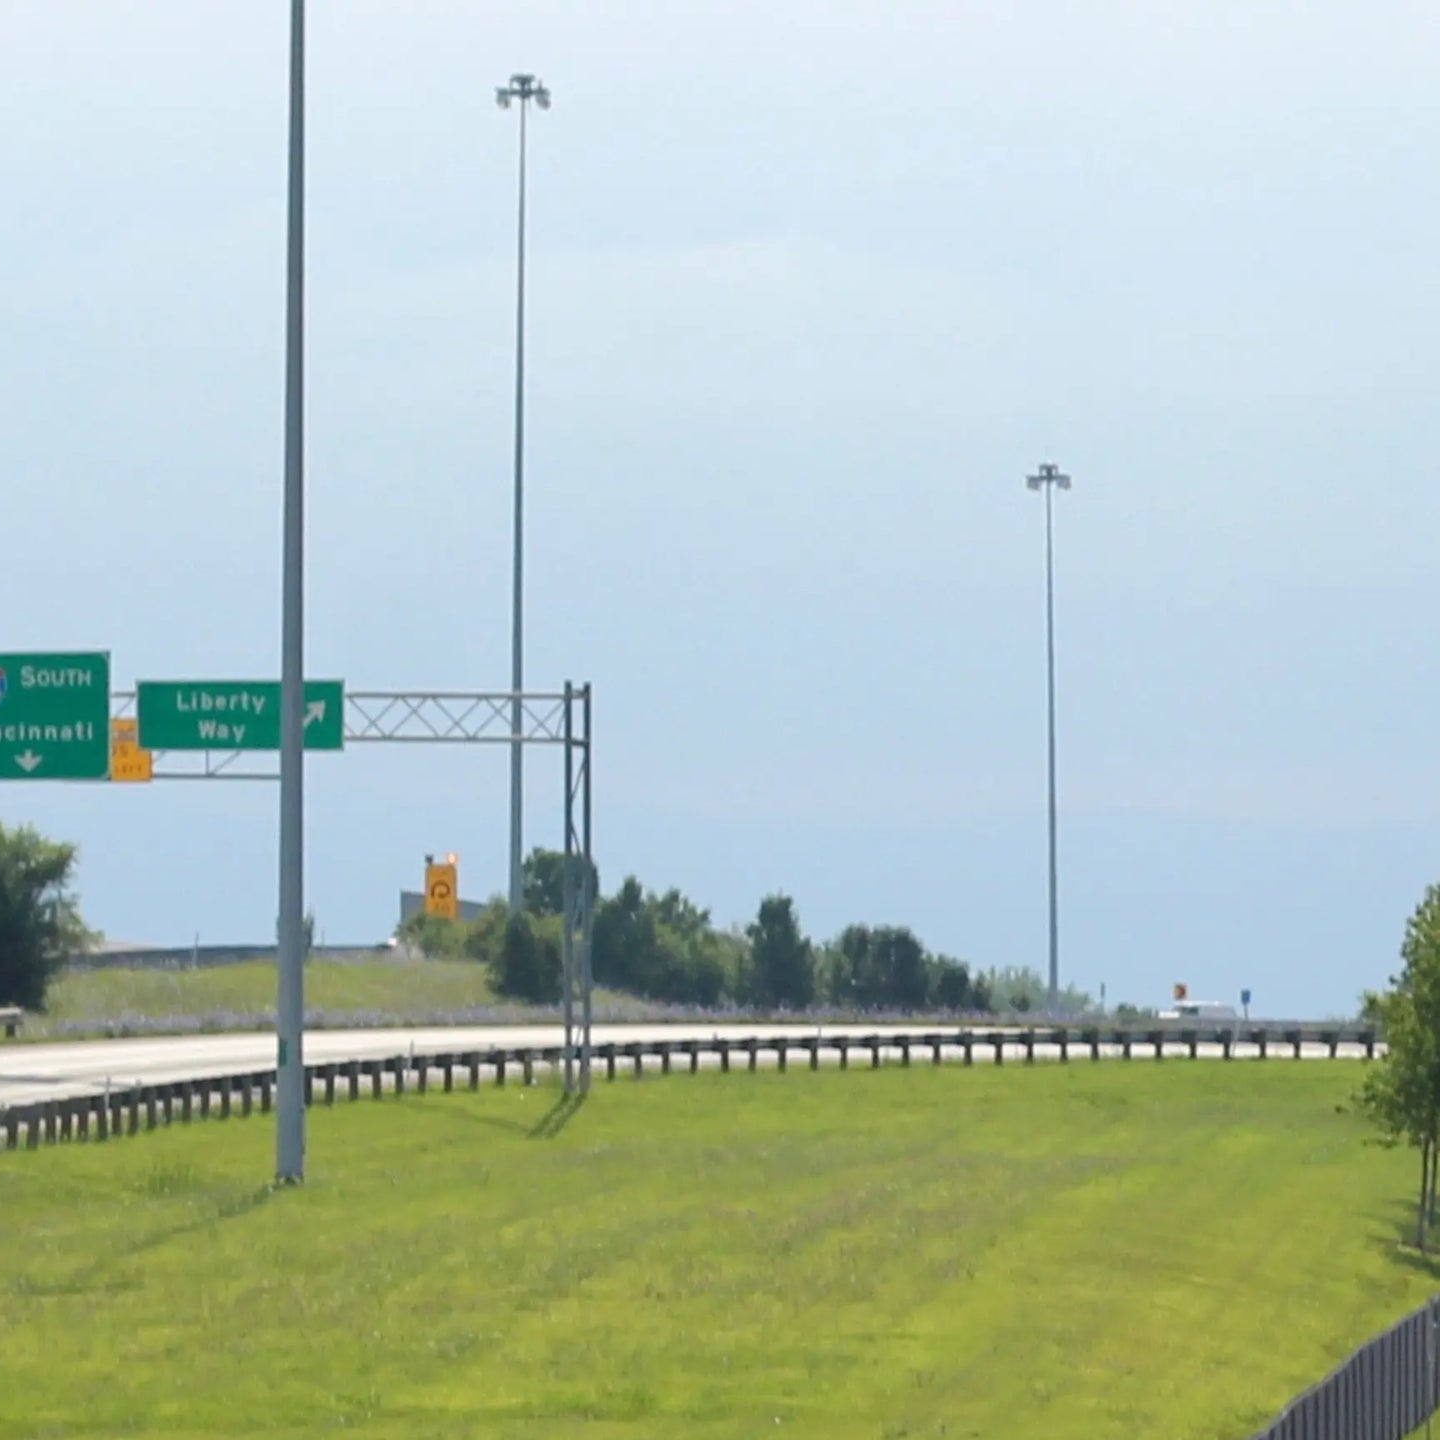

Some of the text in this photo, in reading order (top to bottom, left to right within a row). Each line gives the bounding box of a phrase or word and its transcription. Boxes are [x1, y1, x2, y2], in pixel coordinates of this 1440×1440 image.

[21, 665, 92, 688] SOUTH
[176, 690, 266, 714] Liberty
[198, 719, 246, 743] Way
